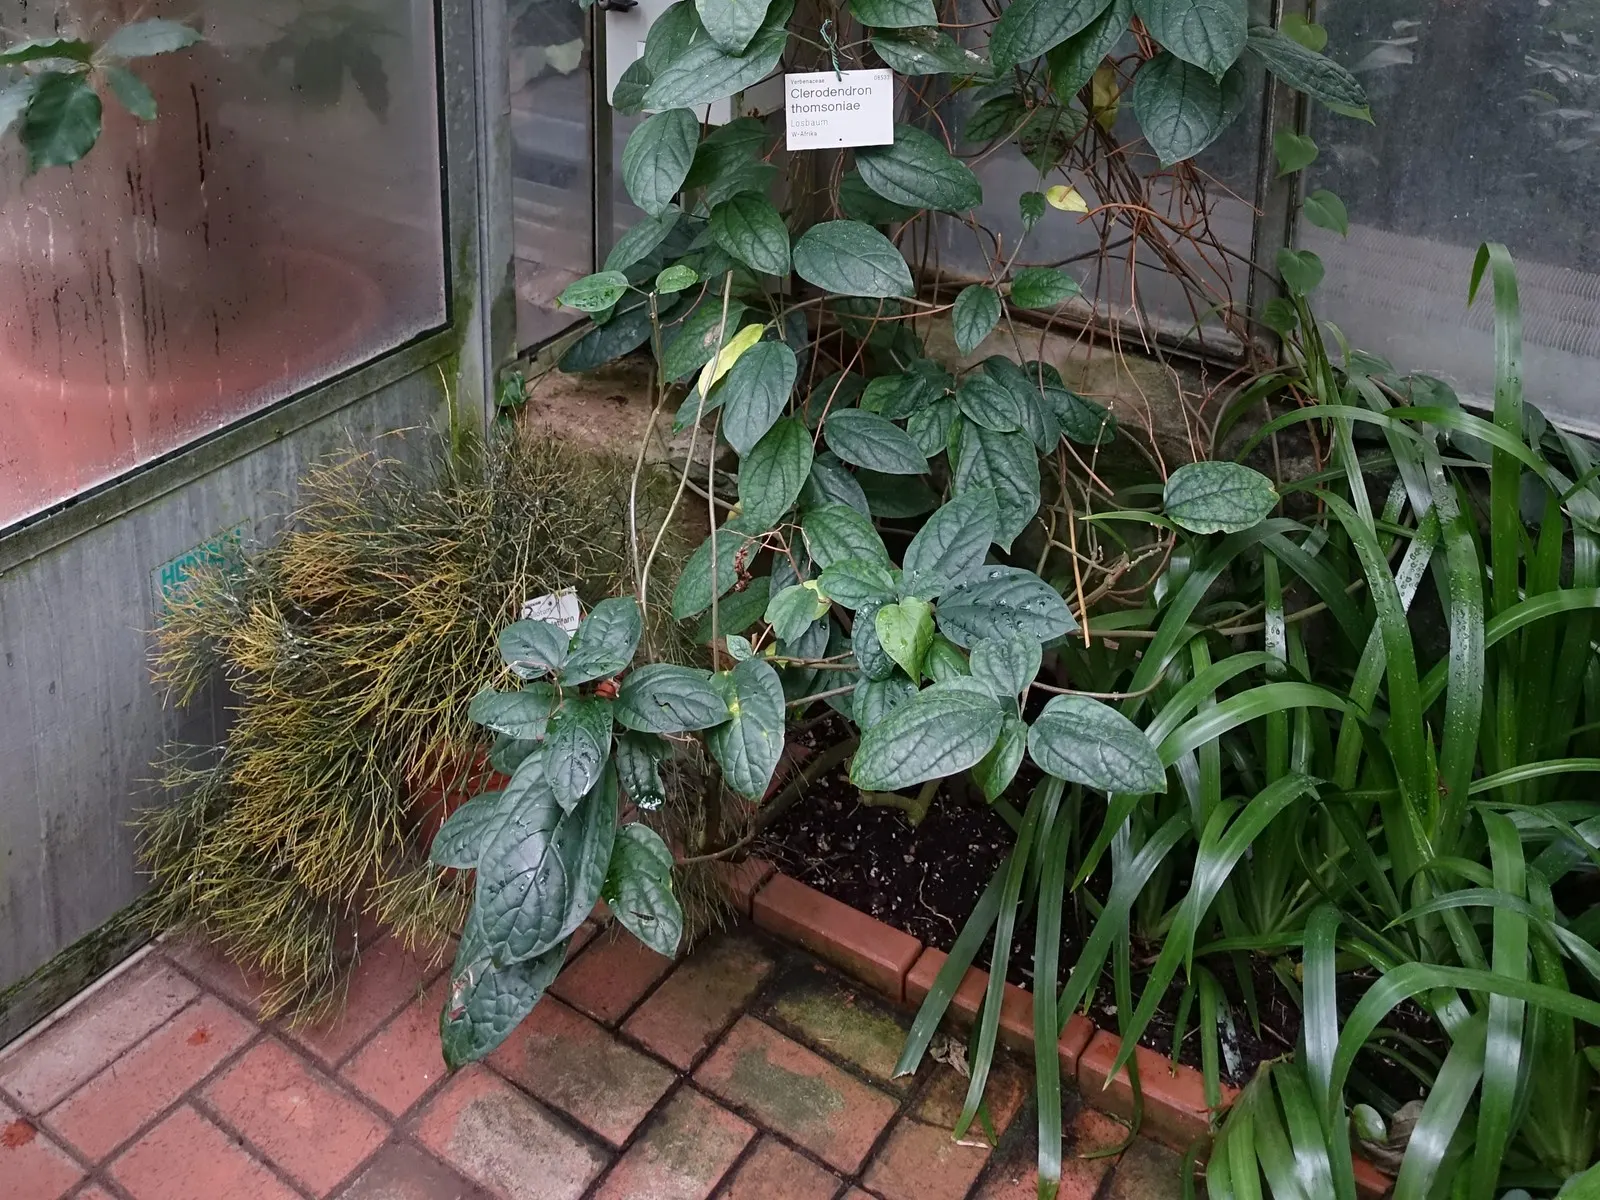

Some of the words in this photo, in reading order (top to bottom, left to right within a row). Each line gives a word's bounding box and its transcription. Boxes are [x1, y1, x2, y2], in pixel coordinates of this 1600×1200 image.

[790, 86, 872, 99] Clerodendron
[791, 101, 861, 114] thomsoniae
[790, 119, 828, 128] Losbaum
